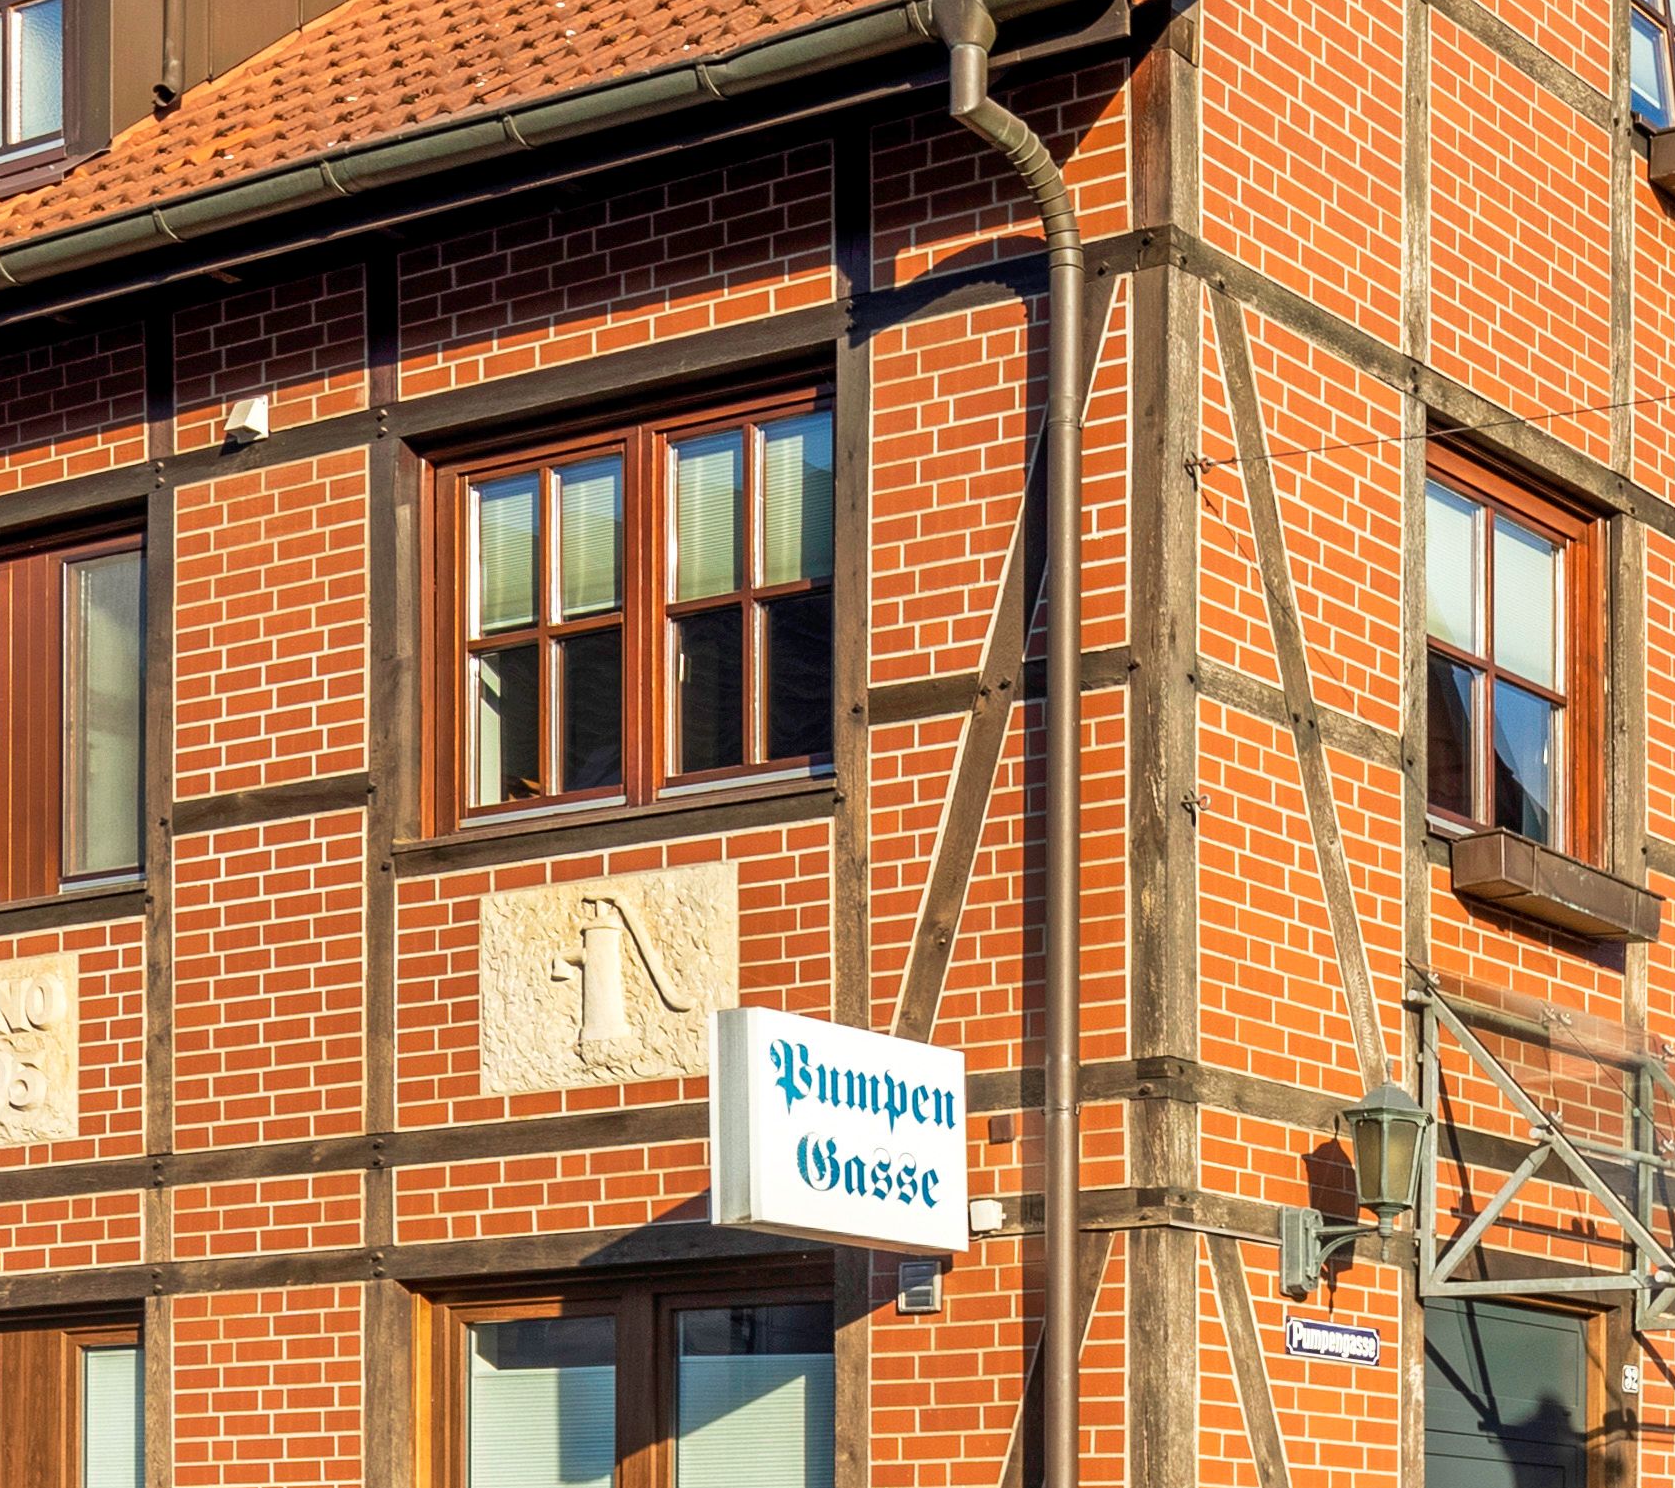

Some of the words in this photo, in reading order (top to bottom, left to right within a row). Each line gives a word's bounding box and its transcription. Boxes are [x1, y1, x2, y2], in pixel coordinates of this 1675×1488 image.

[769, 1038, 957, 1135] Pumpen
[796, 1131, 941, 1209] Gasse
[1291, 1320, 1377, 1359] Pumpengasse
